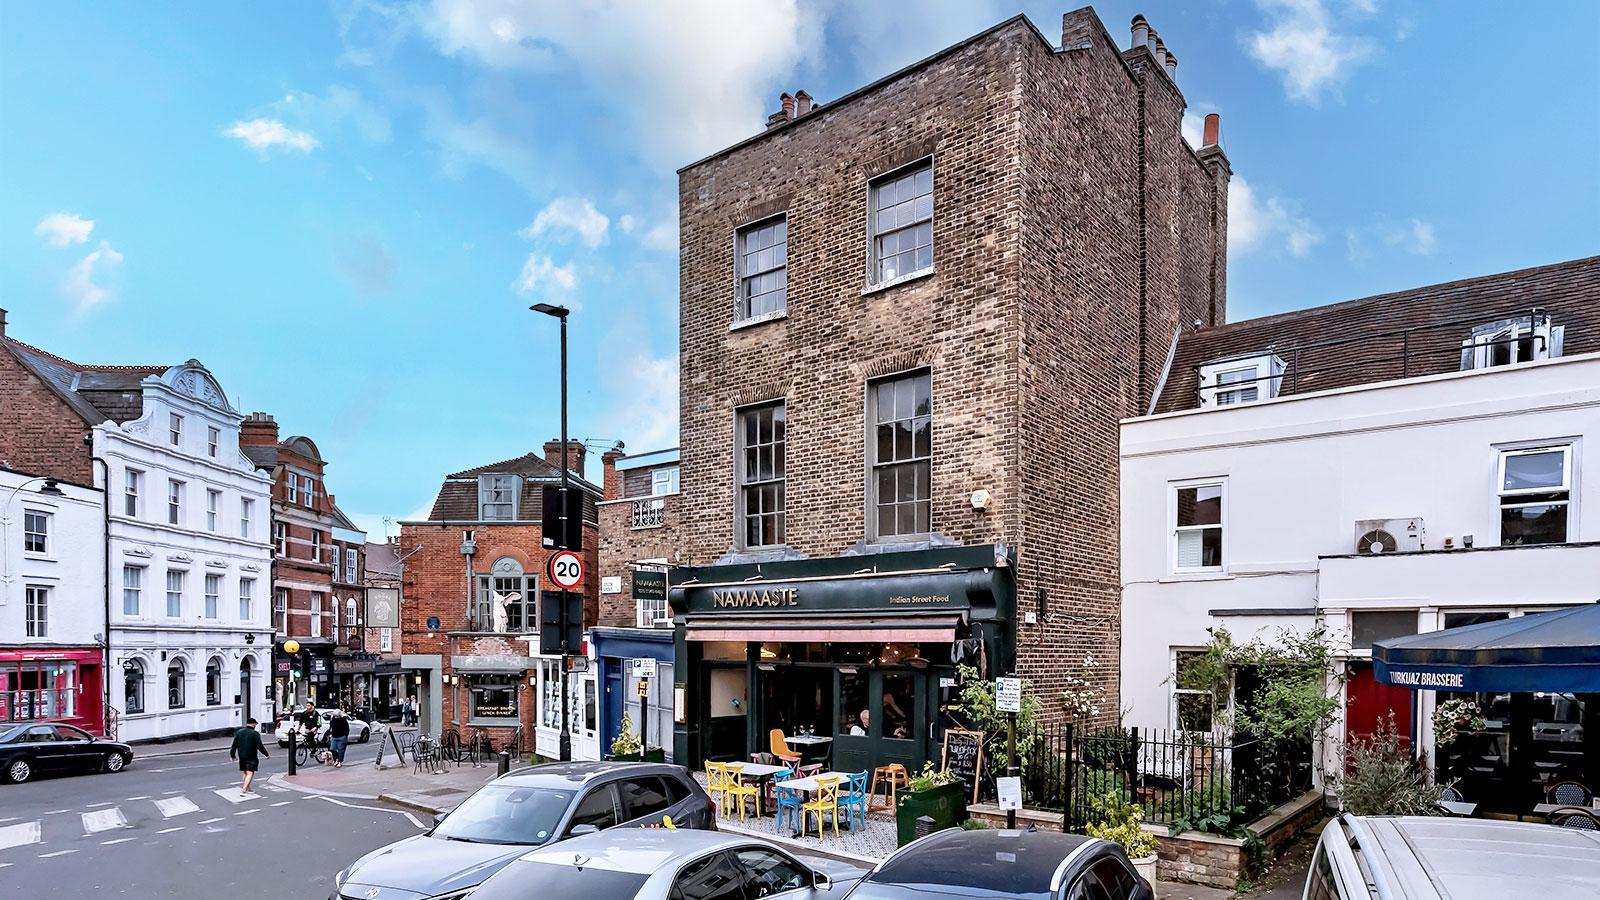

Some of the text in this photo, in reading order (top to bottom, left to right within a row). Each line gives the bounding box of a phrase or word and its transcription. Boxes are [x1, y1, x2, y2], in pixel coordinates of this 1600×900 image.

[557, 561, 580, 578] 20
[713, 587, 798, 608] NAMAASTE
[889, 594, 949, 604] Indian Street Food
[1389, 671, 1464, 688] TURKUAZ BRASSERIE
